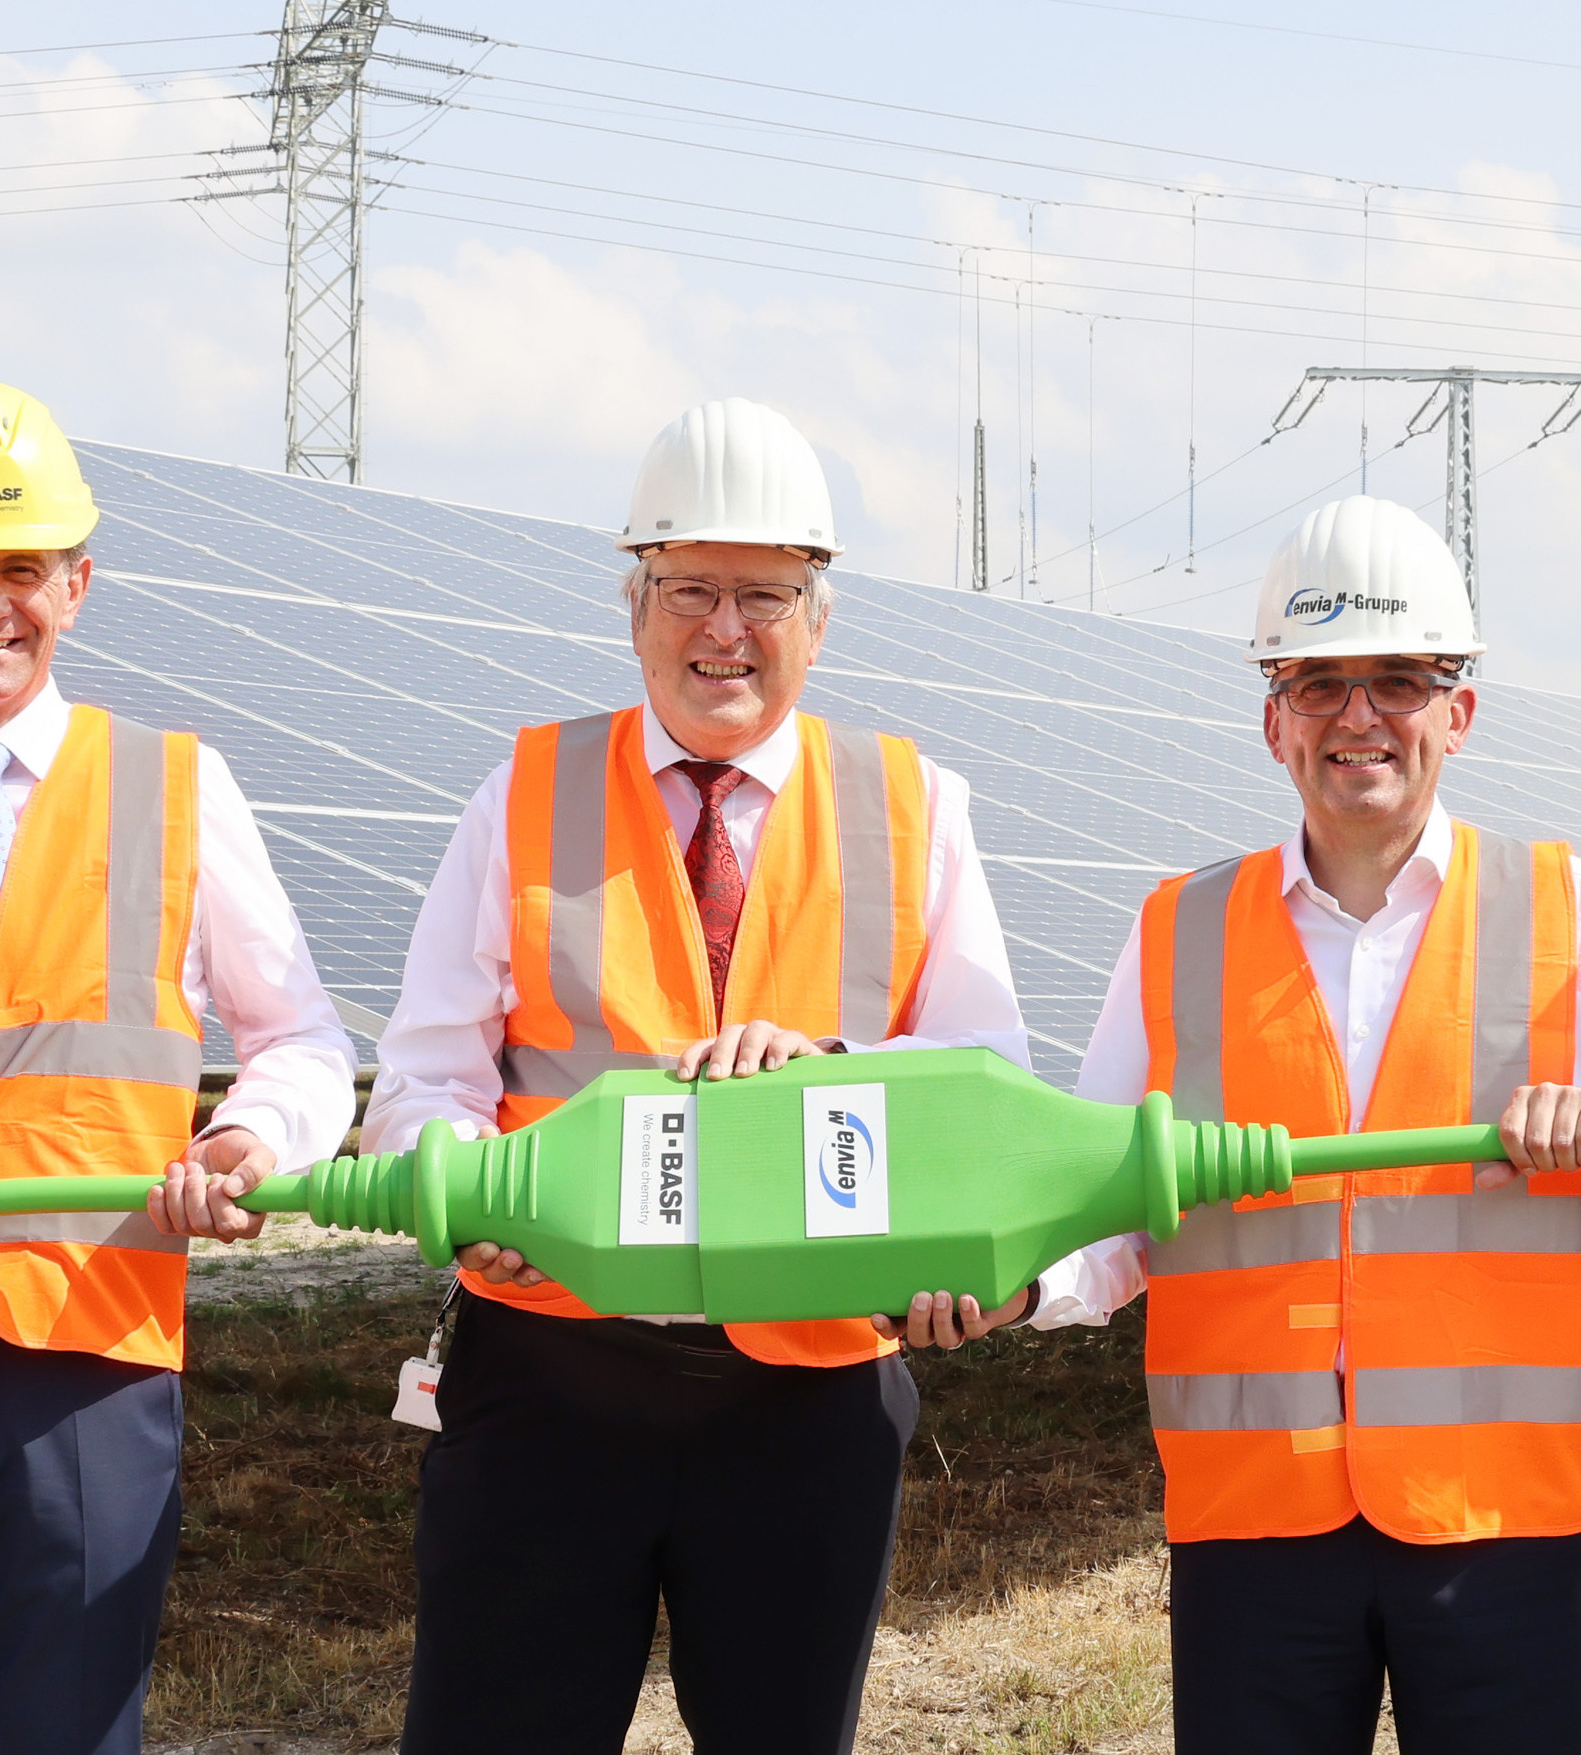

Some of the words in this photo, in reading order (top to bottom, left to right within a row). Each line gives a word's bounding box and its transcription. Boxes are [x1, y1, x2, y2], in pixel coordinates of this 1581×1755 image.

[642, 1113, 654, 1131] We
[641, 1133, 652, 1167] create
[637, 1171, 651, 1226] chemistry
[659, 1152, 683, 1225] BASF
